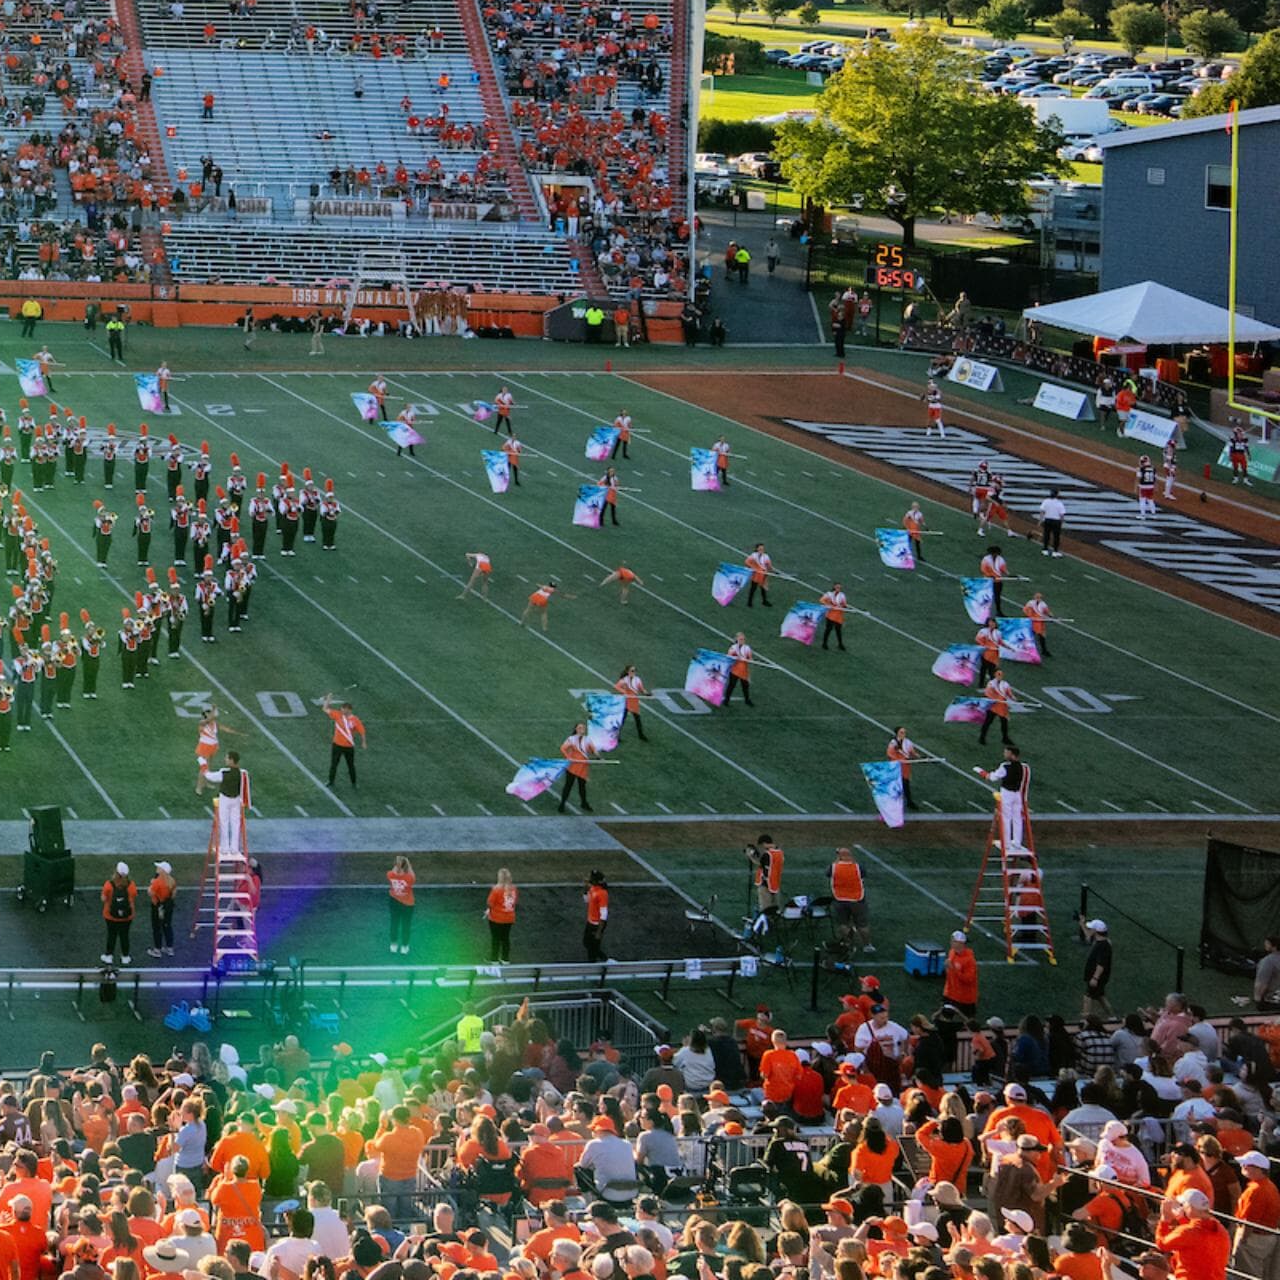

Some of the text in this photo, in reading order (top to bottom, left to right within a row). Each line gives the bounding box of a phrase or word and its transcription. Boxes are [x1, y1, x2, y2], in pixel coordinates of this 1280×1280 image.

[876, 244, 903, 267] 25
[877, 268, 914, 288] 6:59
[292, 288, 320, 303] 1959
[325, 289, 389, 305] NATONAL
[796, 1151, 808, 1172] 7
